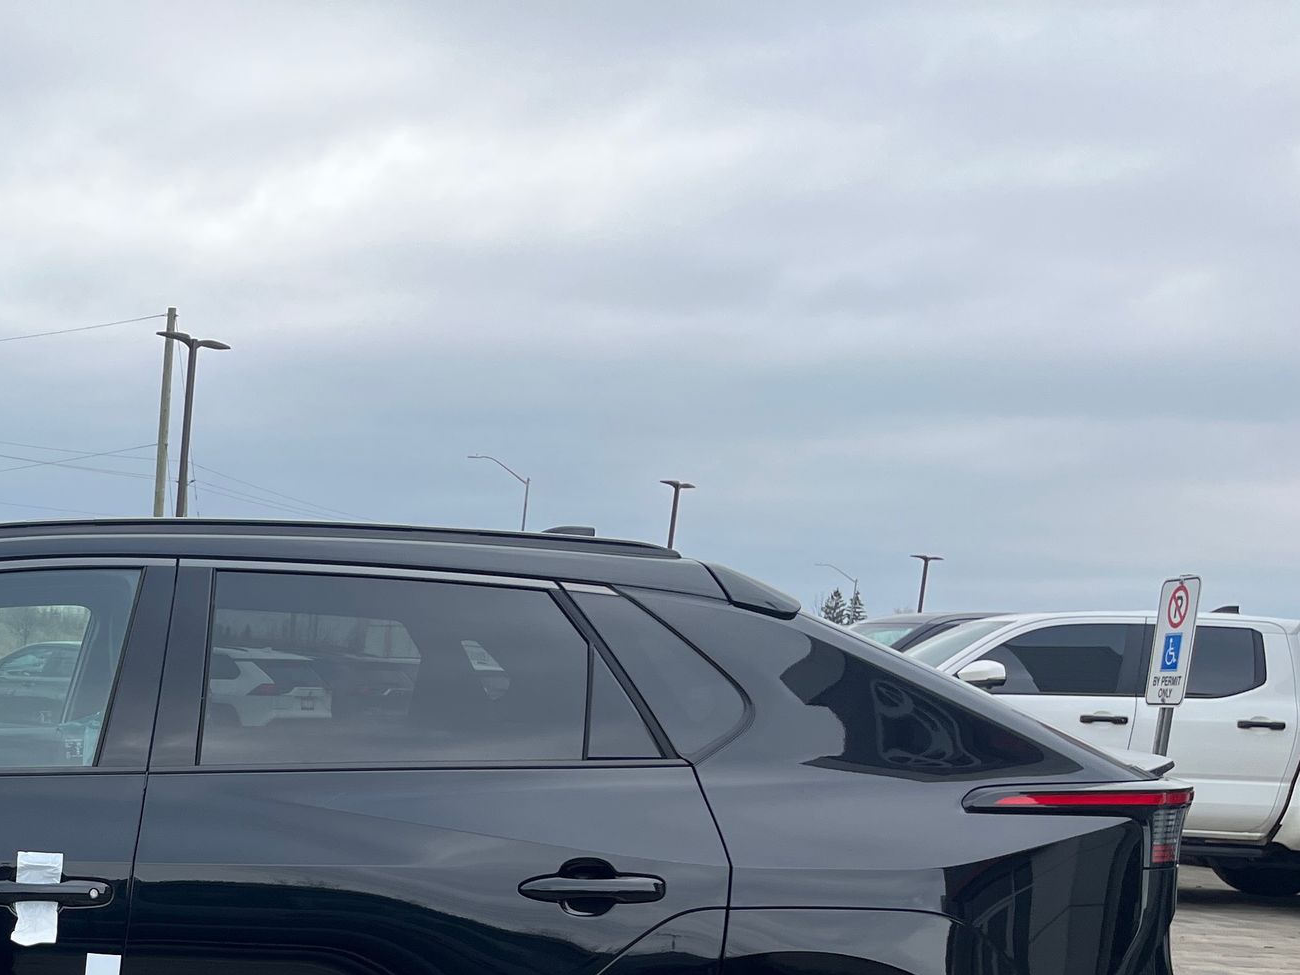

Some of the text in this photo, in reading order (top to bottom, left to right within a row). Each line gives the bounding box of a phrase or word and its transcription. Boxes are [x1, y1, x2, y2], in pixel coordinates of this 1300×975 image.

[1153, 675, 1182, 686] BY PERMIT
[1157, 688, 1173, 698] ONLY
